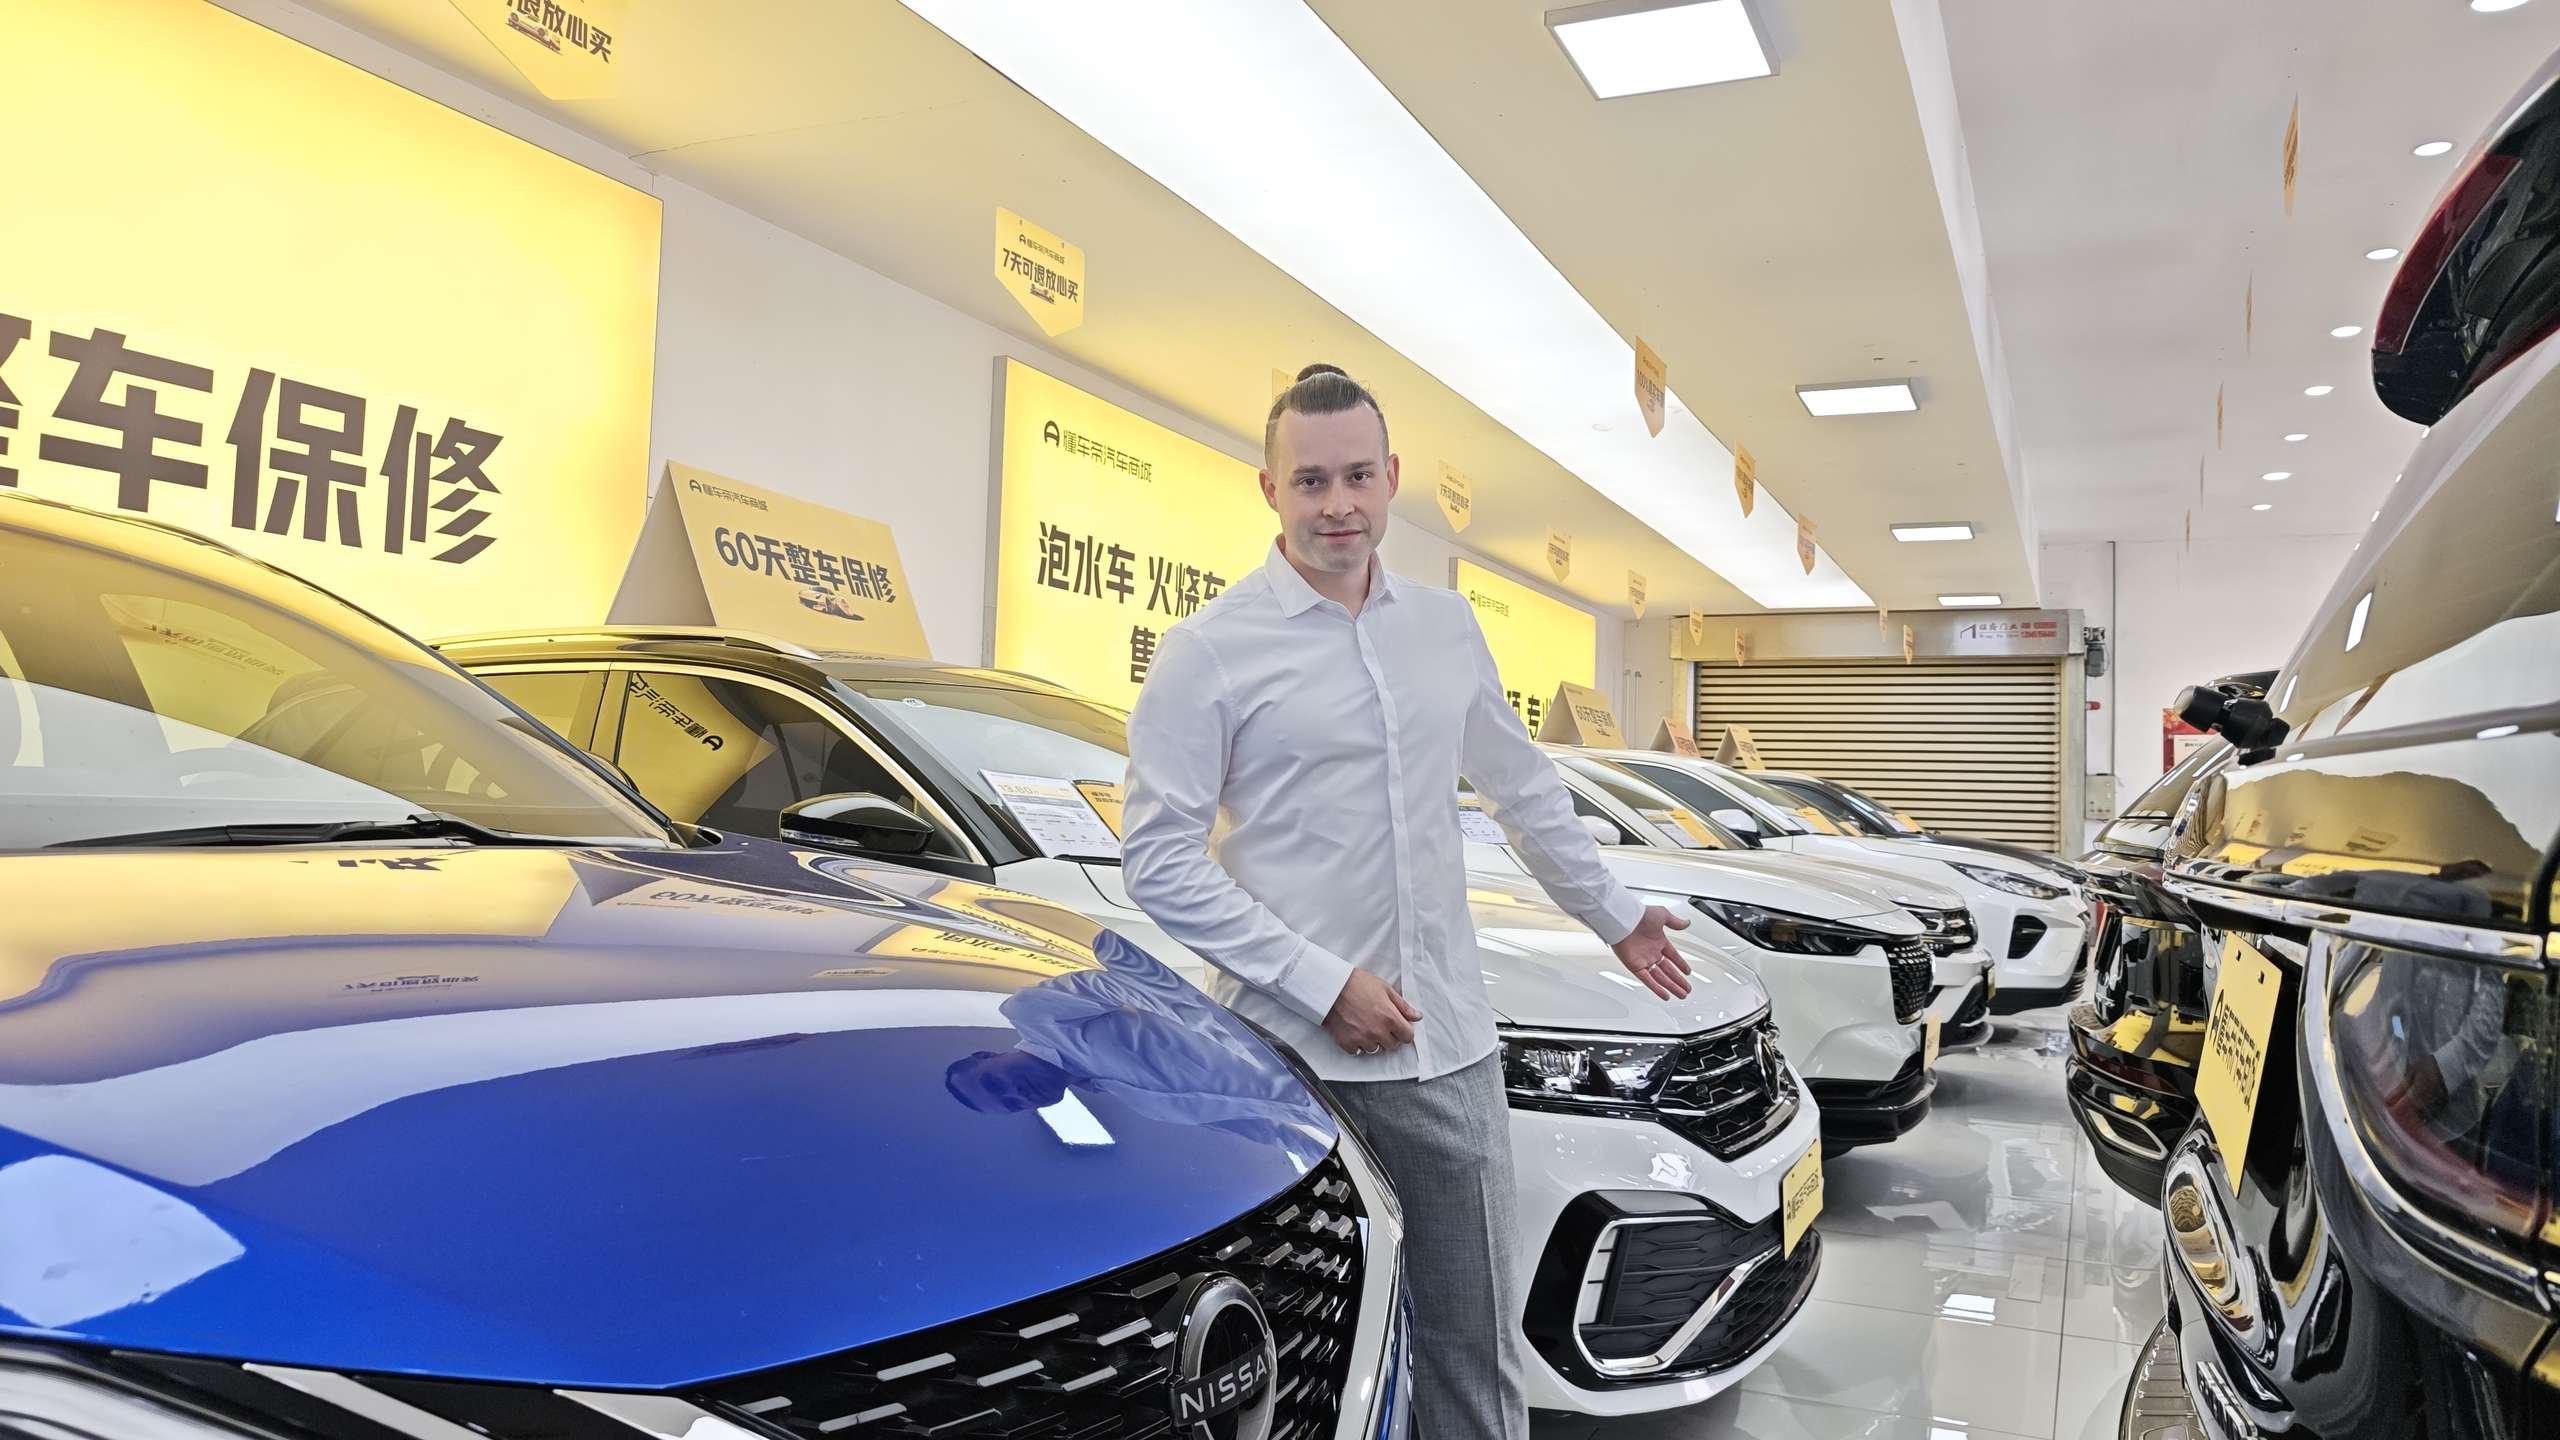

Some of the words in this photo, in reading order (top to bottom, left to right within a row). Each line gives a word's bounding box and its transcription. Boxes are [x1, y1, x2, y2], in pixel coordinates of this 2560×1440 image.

[1002, 247, 1079, 303] 7天可退放心买
[0, 312, 505, 565] 车保修
[714, 526, 897, 604] 60天整车保修
[1037, 521, 1136, 604] 泡水车
